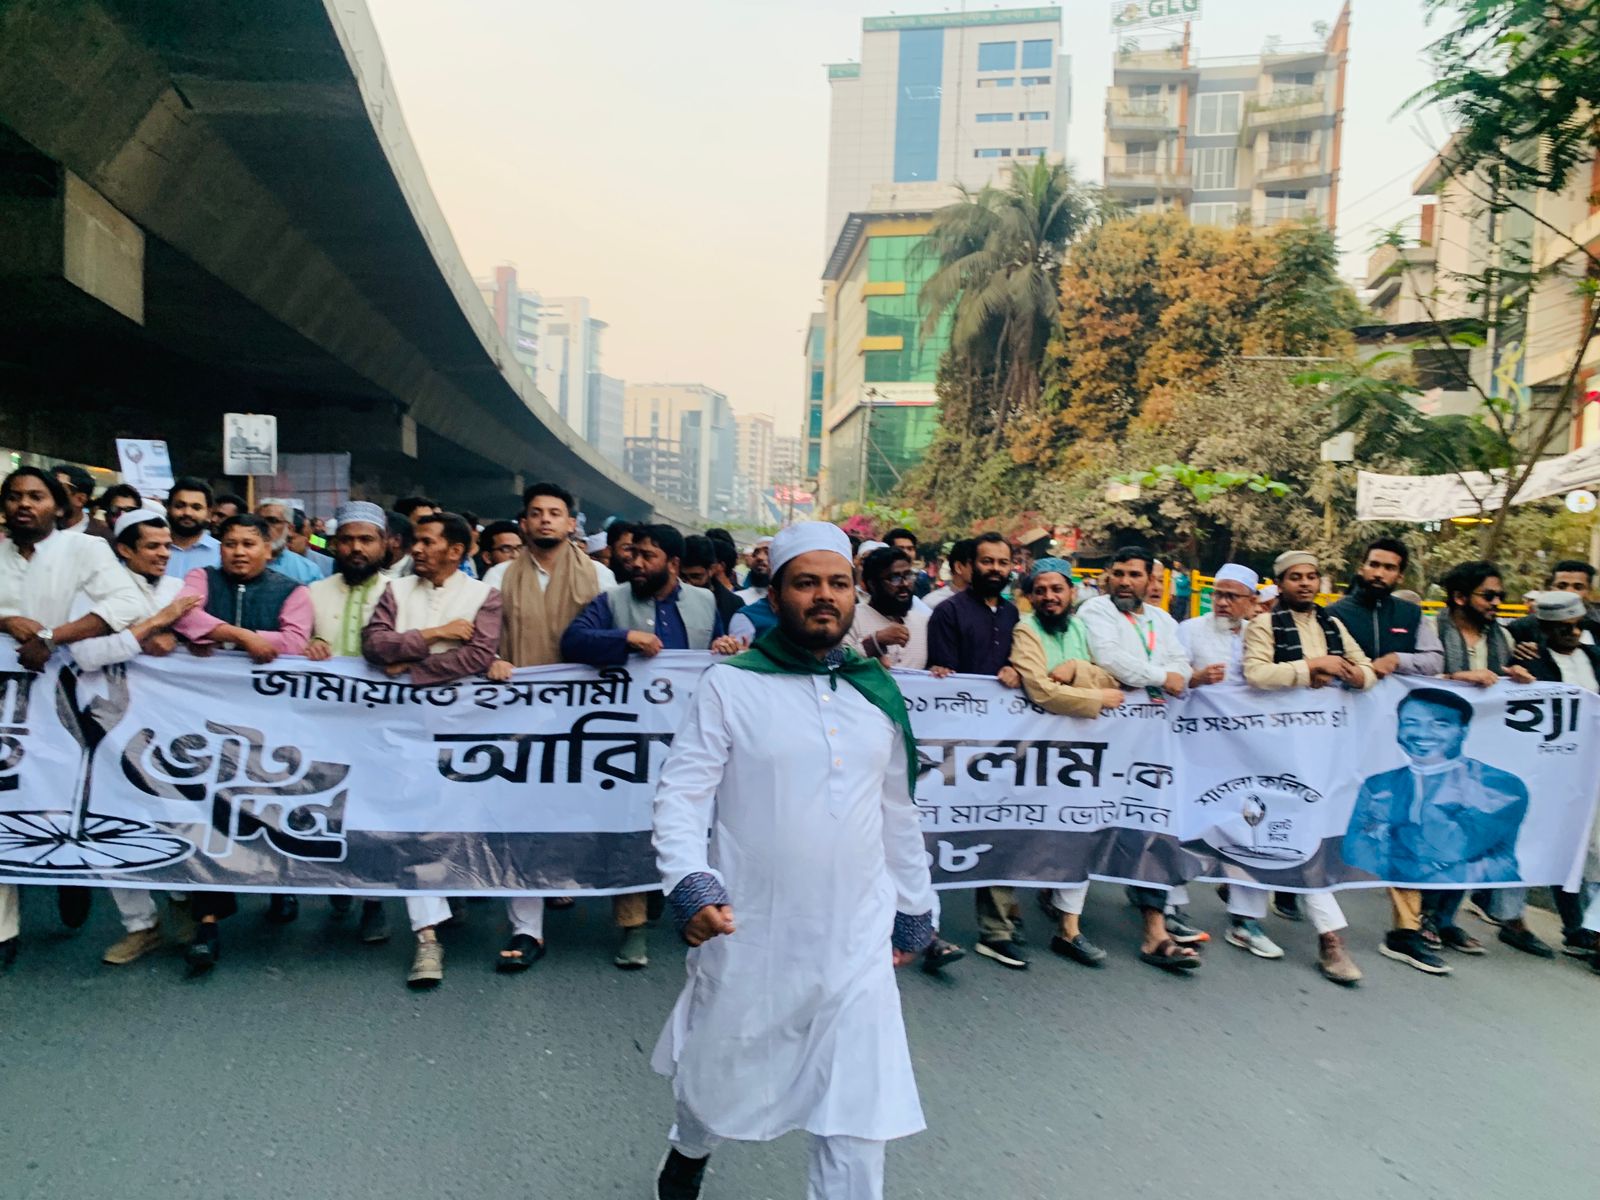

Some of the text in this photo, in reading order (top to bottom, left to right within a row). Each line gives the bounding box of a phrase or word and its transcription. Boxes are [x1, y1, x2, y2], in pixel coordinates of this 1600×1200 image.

[643, 677, 674, 704] ও
[934, 691, 988, 717] দলীয়
[1203, 714, 1264, 732] সংসদ
[434, 711, 675, 790] আরি
[926, 840, 993, 873] ৮
